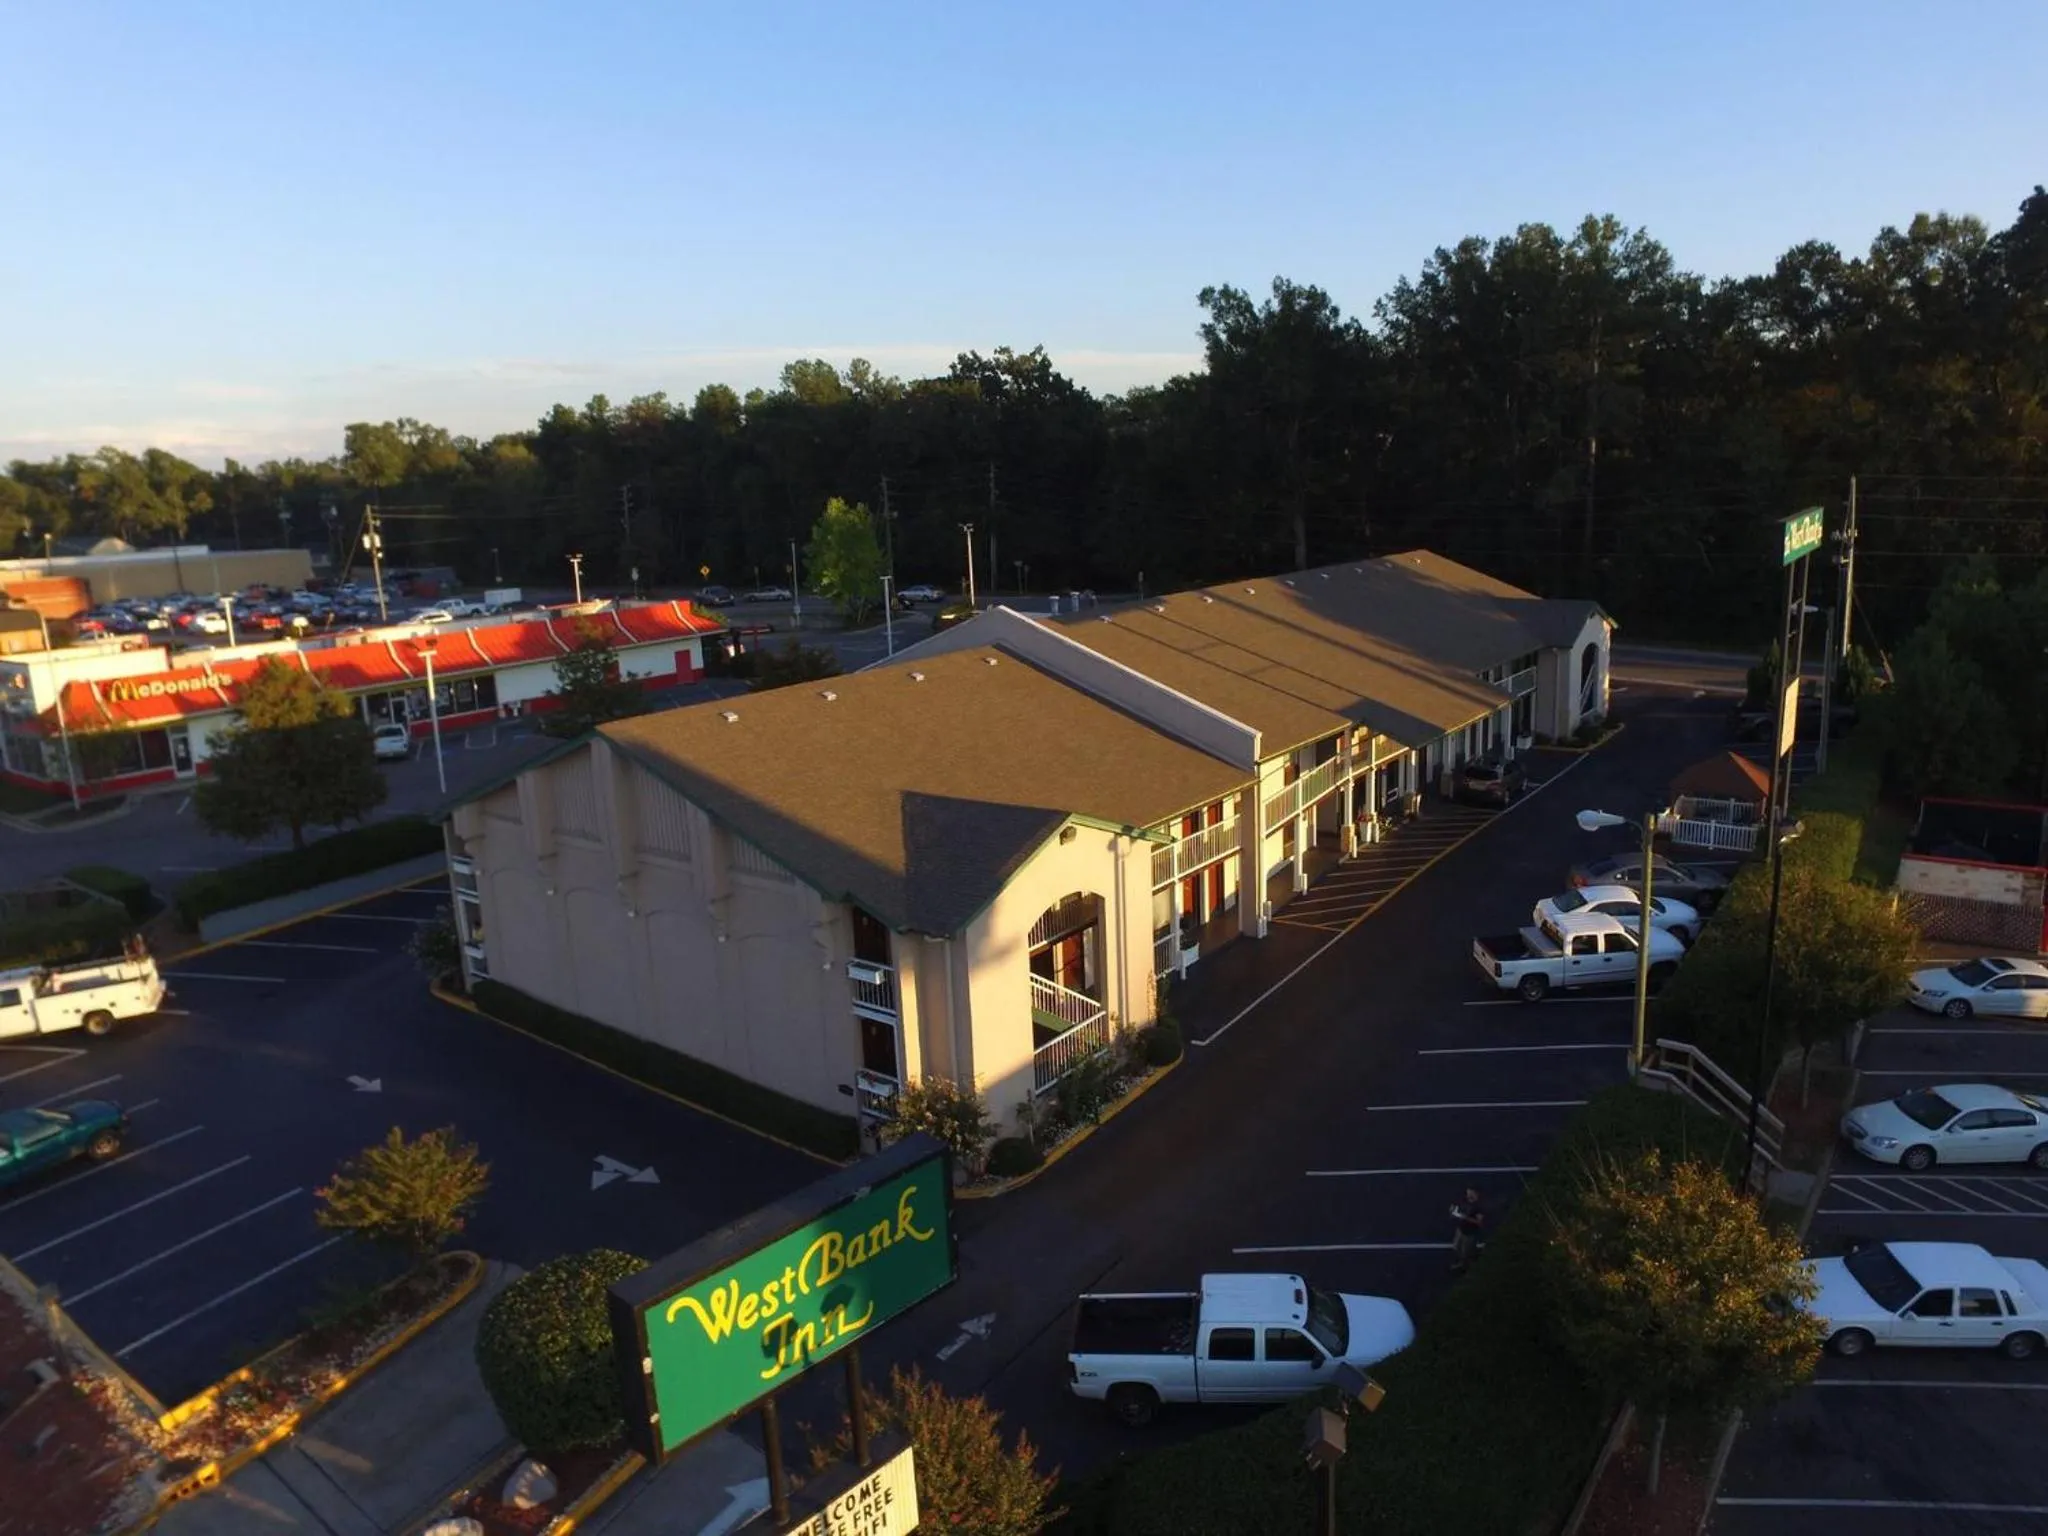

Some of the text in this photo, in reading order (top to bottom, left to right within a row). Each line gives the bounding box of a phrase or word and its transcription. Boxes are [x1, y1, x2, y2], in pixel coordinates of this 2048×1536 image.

[110, 673, 234, 702] McDonald's
[760, 1301, 873, 1379] Inn
[853, 1487, 893, 1529] FREE
